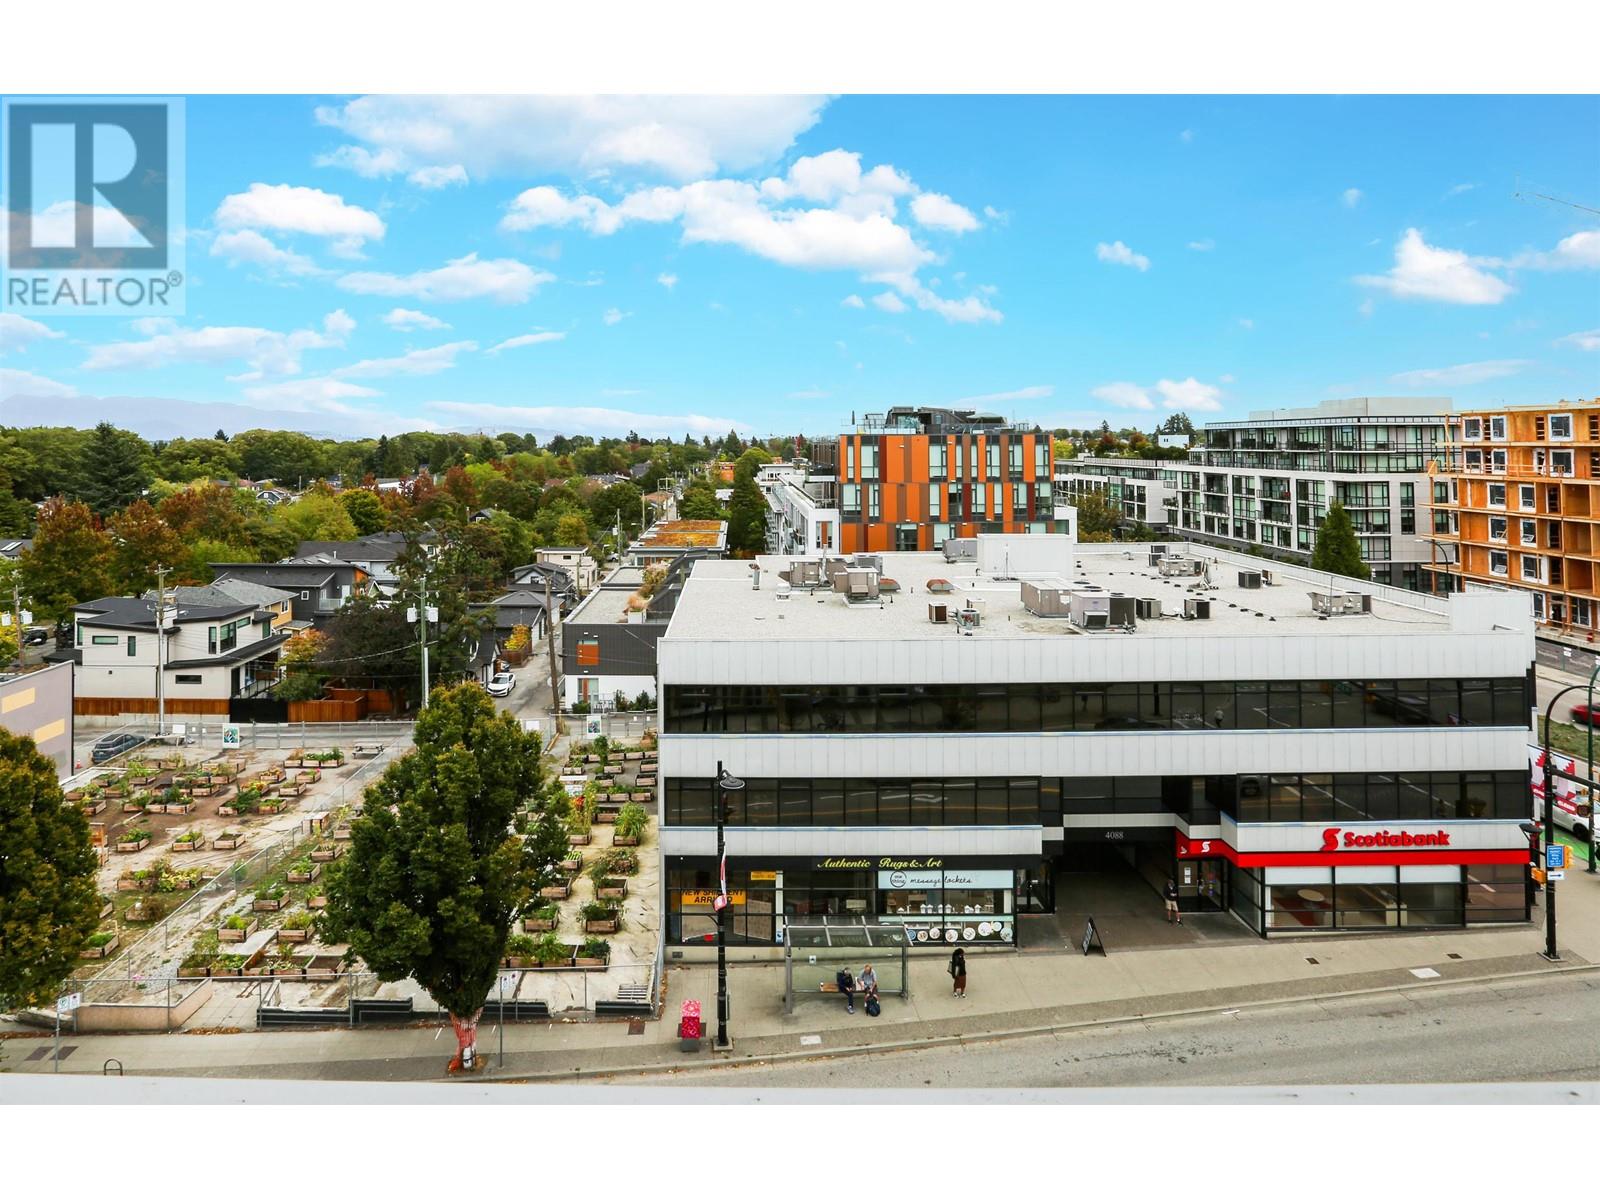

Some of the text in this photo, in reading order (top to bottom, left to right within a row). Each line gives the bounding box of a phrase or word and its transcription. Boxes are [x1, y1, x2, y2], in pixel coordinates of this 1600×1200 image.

[1105, 831, 1124, 840] 4088
[1343, 830, 1450, 847] Scotiabank
[817, 858, 871, 868] Authentic
[694, 896, 733, 904] ARRD
